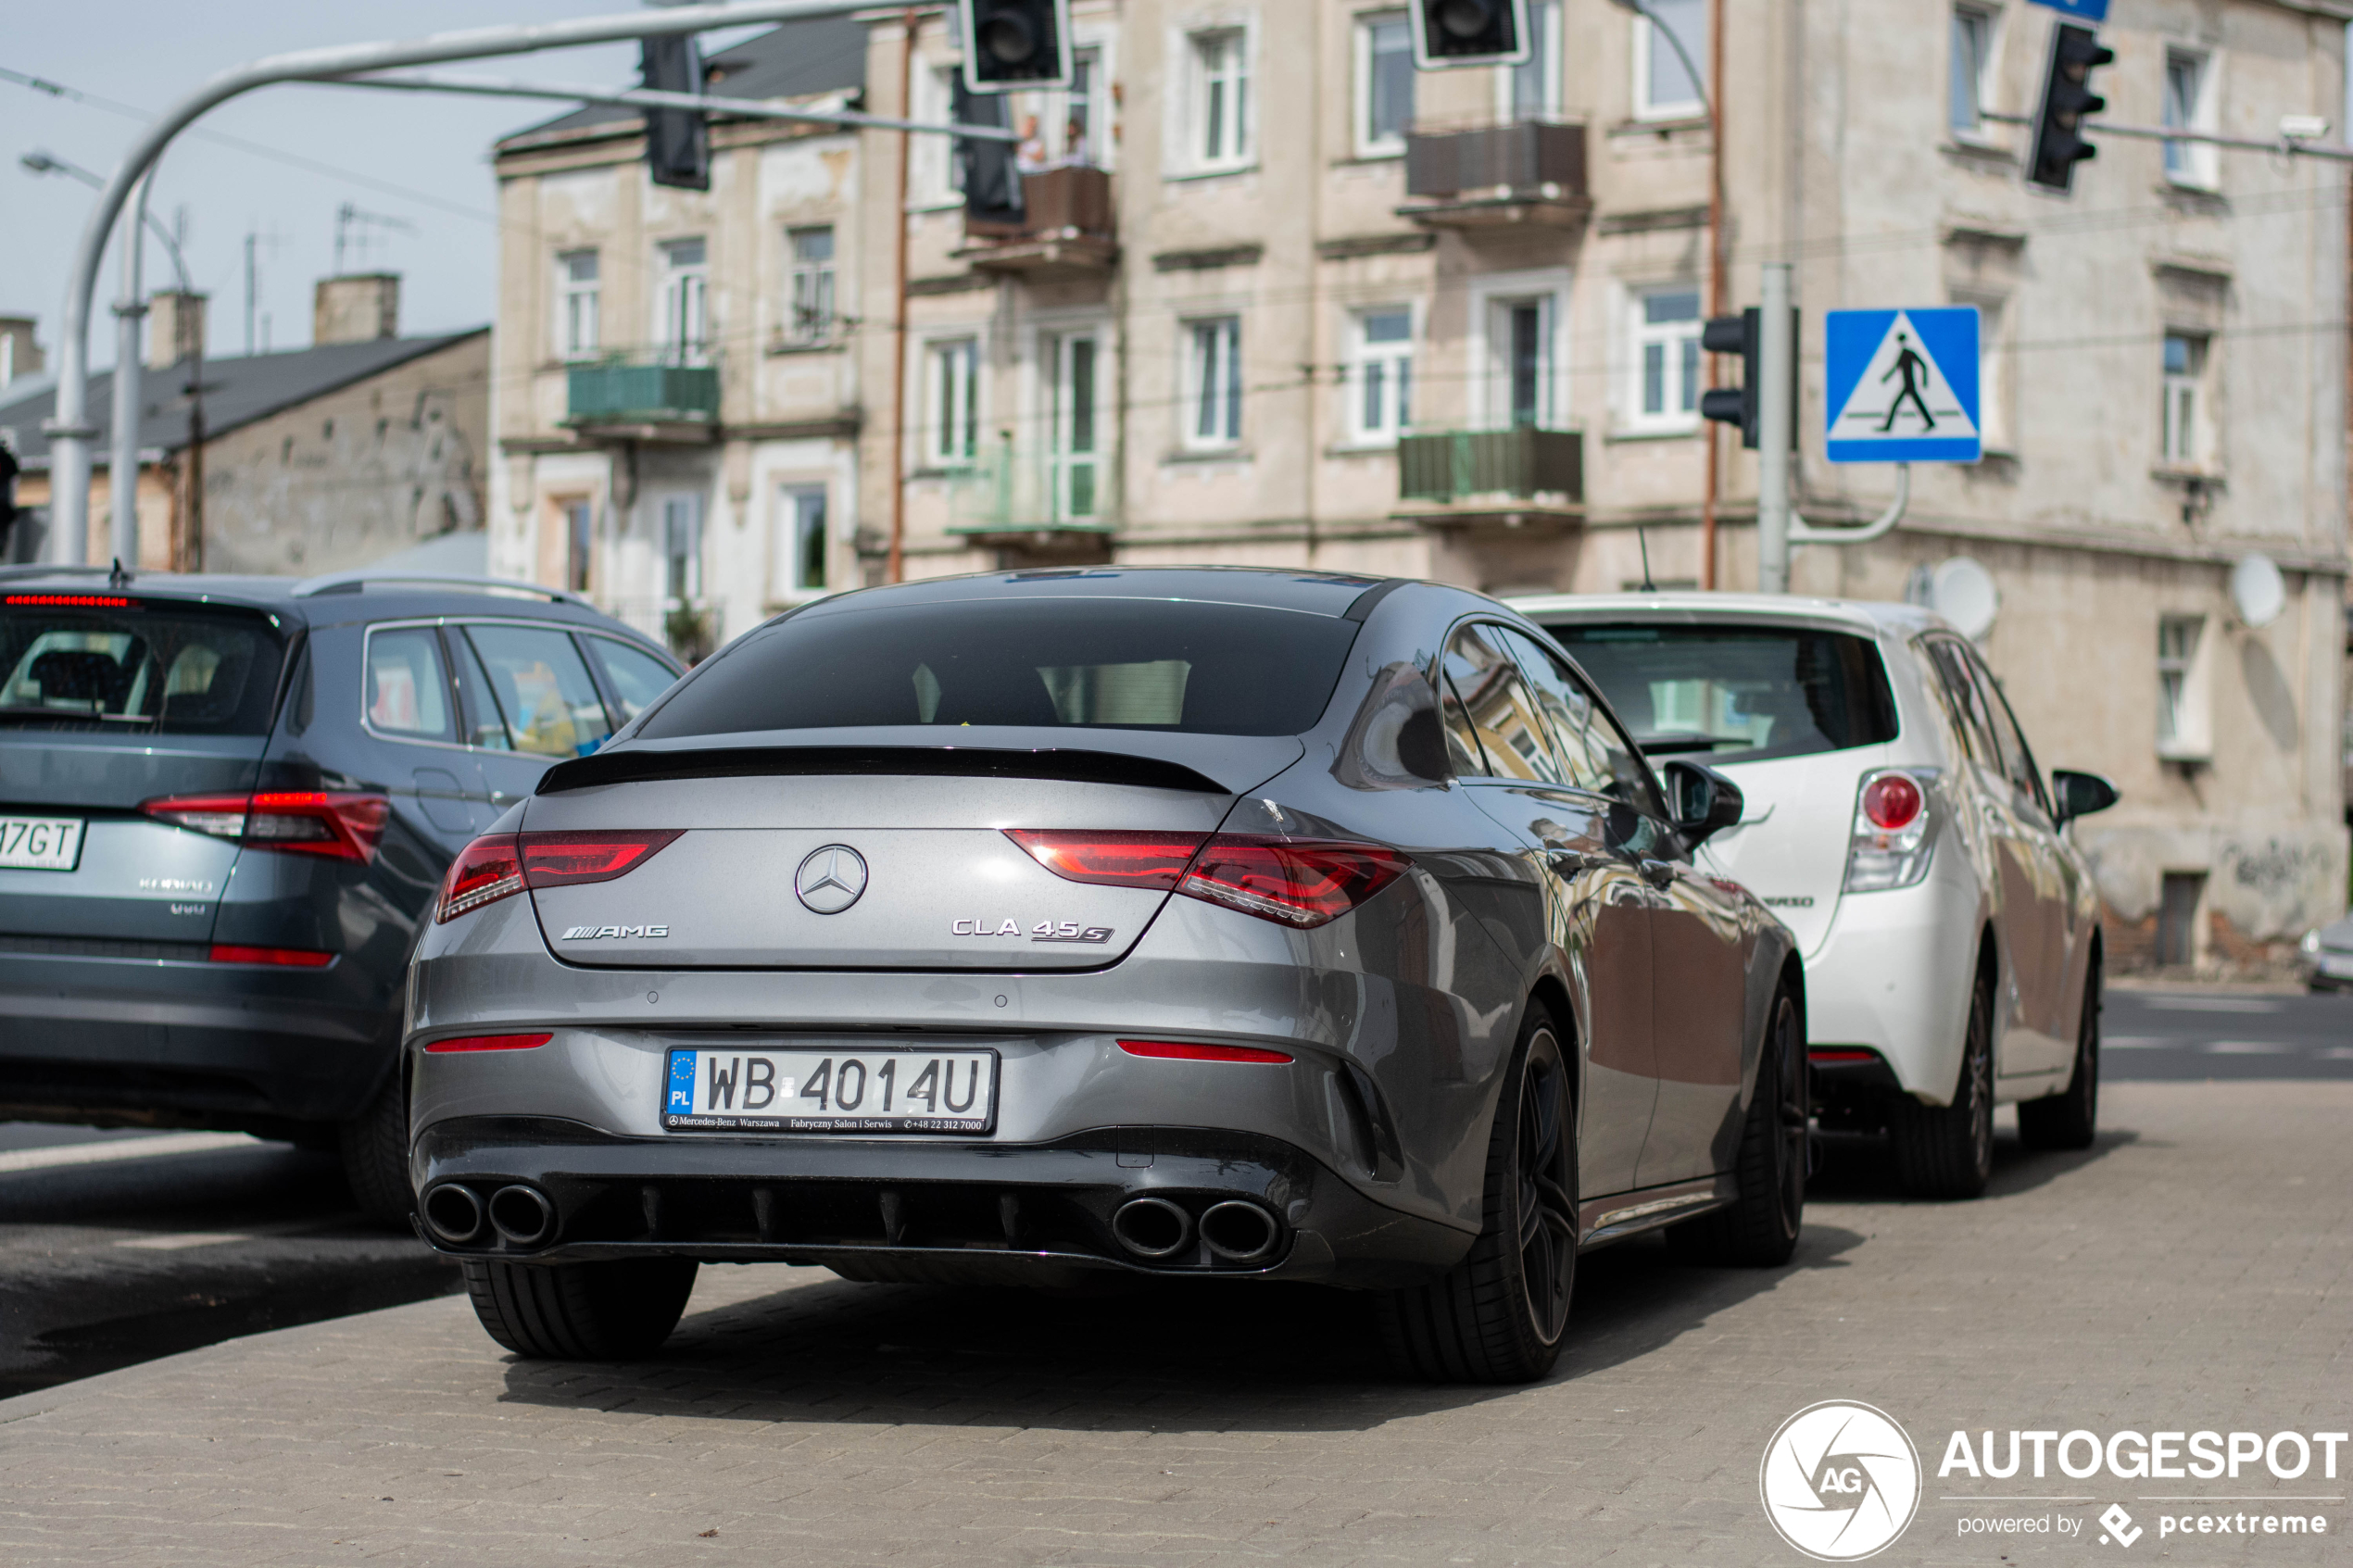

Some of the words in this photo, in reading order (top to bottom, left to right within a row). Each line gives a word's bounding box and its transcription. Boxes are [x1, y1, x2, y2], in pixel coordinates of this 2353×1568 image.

[595, 925, 669, 939] AMG
[952, 919, 1021, 936] CLA
[709, 1057, 775, 1110] WB
[800, 1058, 979, 1113] 4014U
[672, 1091, 690, 1106] PL
[679, 1116, 736, 1127] Mercedes-Benz
[740, 1118, 780, 1128] Warszawa
[790, 1119, 833, 1130] Fabryczny
[835, 1120, 857, 1129] Salon
[864, 1120, 892, 1129] Serwis
[931, 1121, 941, 1129] 22
[943, 1121, 958, 1129] 312
[961, 1121, 982, 1130] 7000
